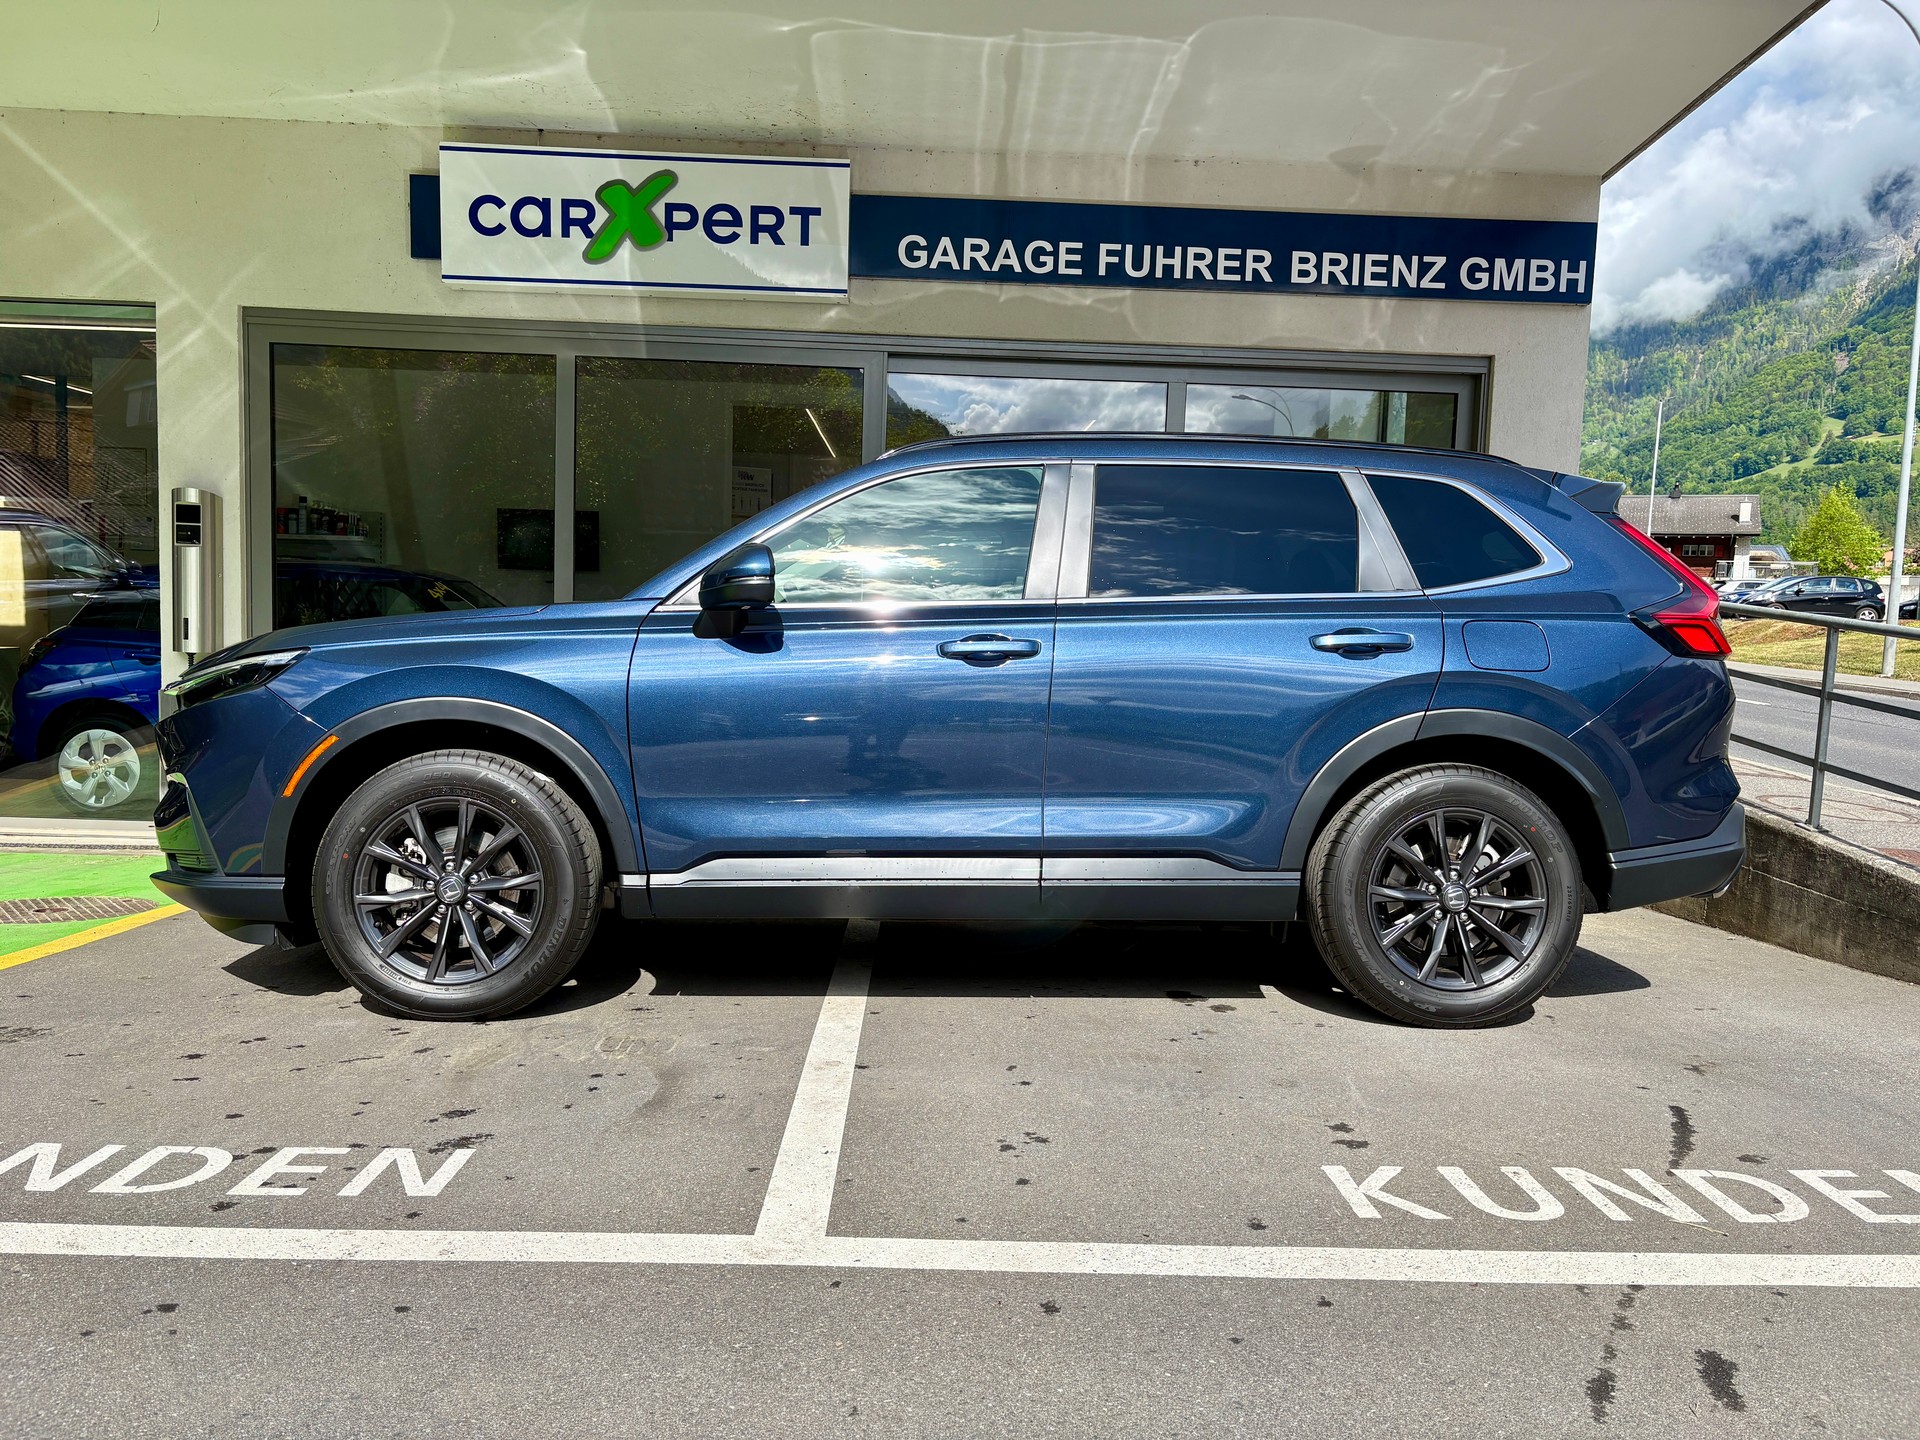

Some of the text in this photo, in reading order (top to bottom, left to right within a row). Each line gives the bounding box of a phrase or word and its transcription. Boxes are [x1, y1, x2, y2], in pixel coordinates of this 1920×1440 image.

[898, 234, 1587, 294] GARAGE FUHRER BRIENZ GMBH
